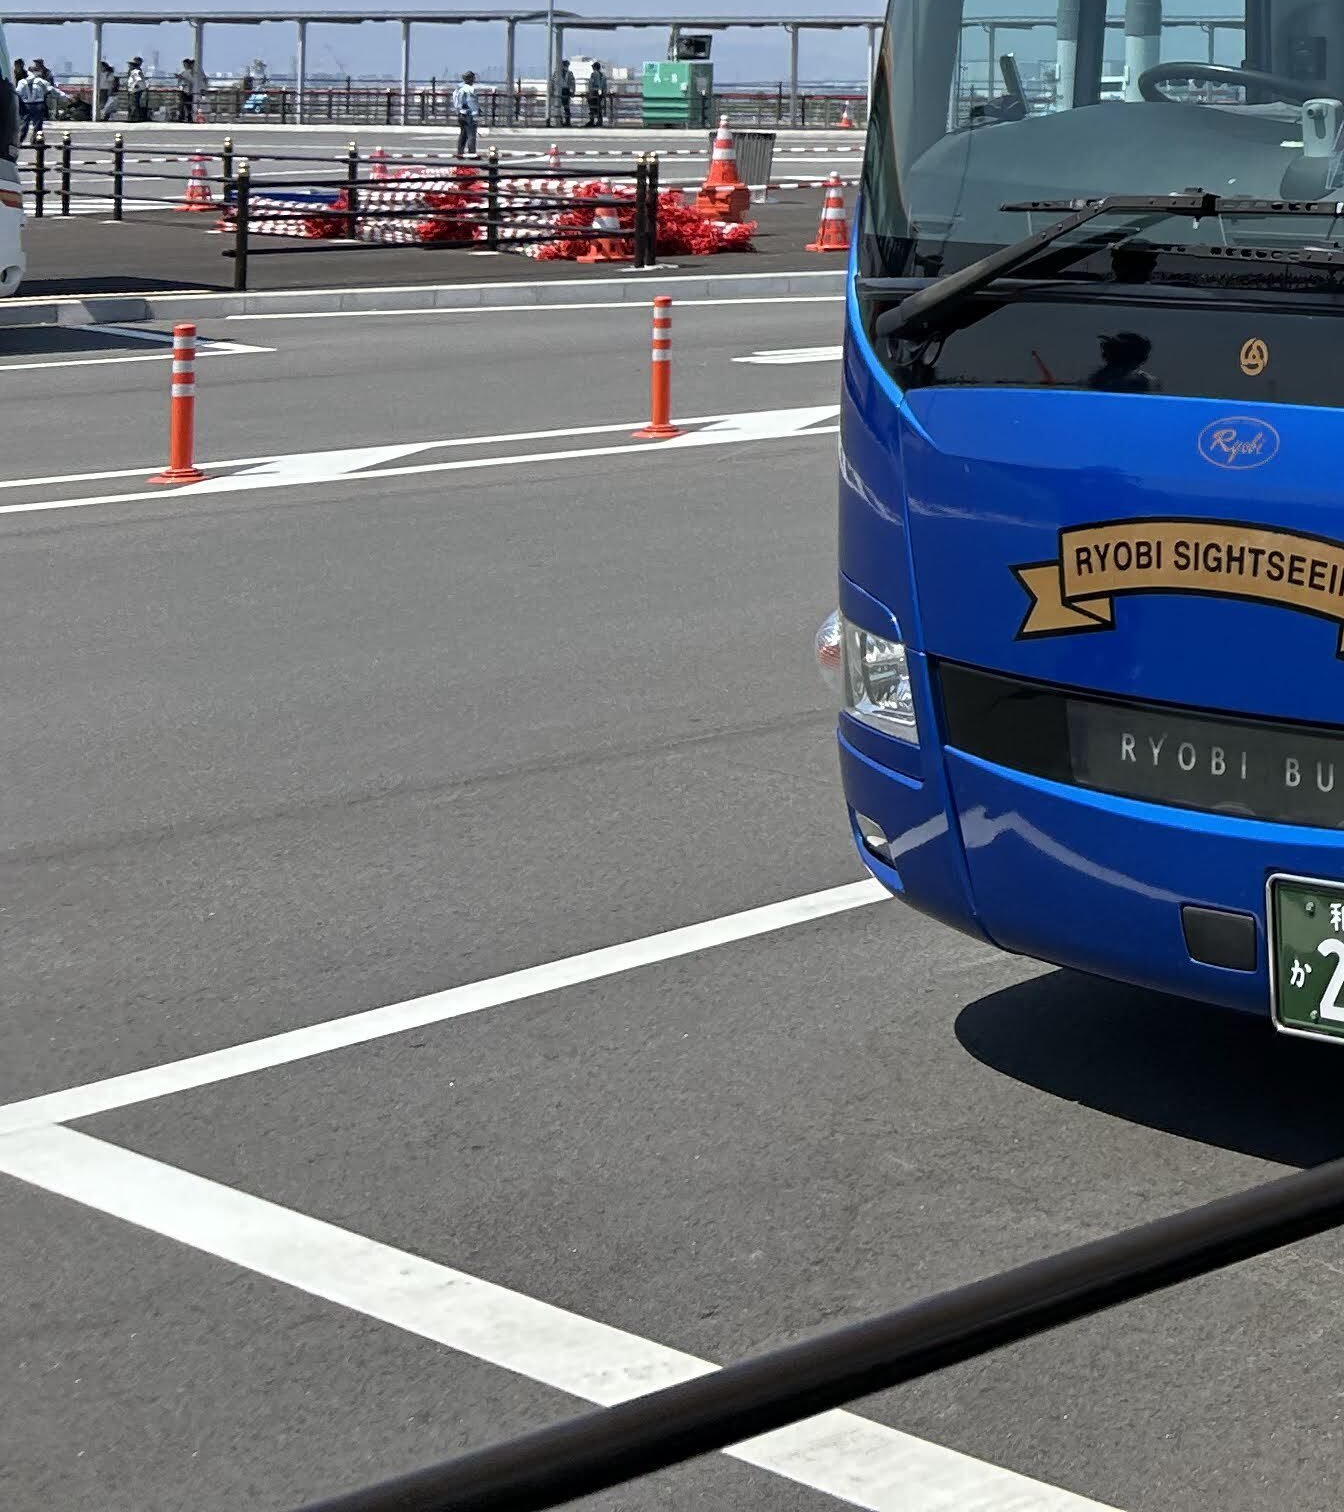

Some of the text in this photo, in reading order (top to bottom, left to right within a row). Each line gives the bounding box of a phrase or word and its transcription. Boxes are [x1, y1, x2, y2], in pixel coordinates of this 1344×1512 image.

[1075, 540, 1162, 576] RYOBI
[1121, 733, 1247, 779] RYOBI
[1289, 959, 1313, 988] か
